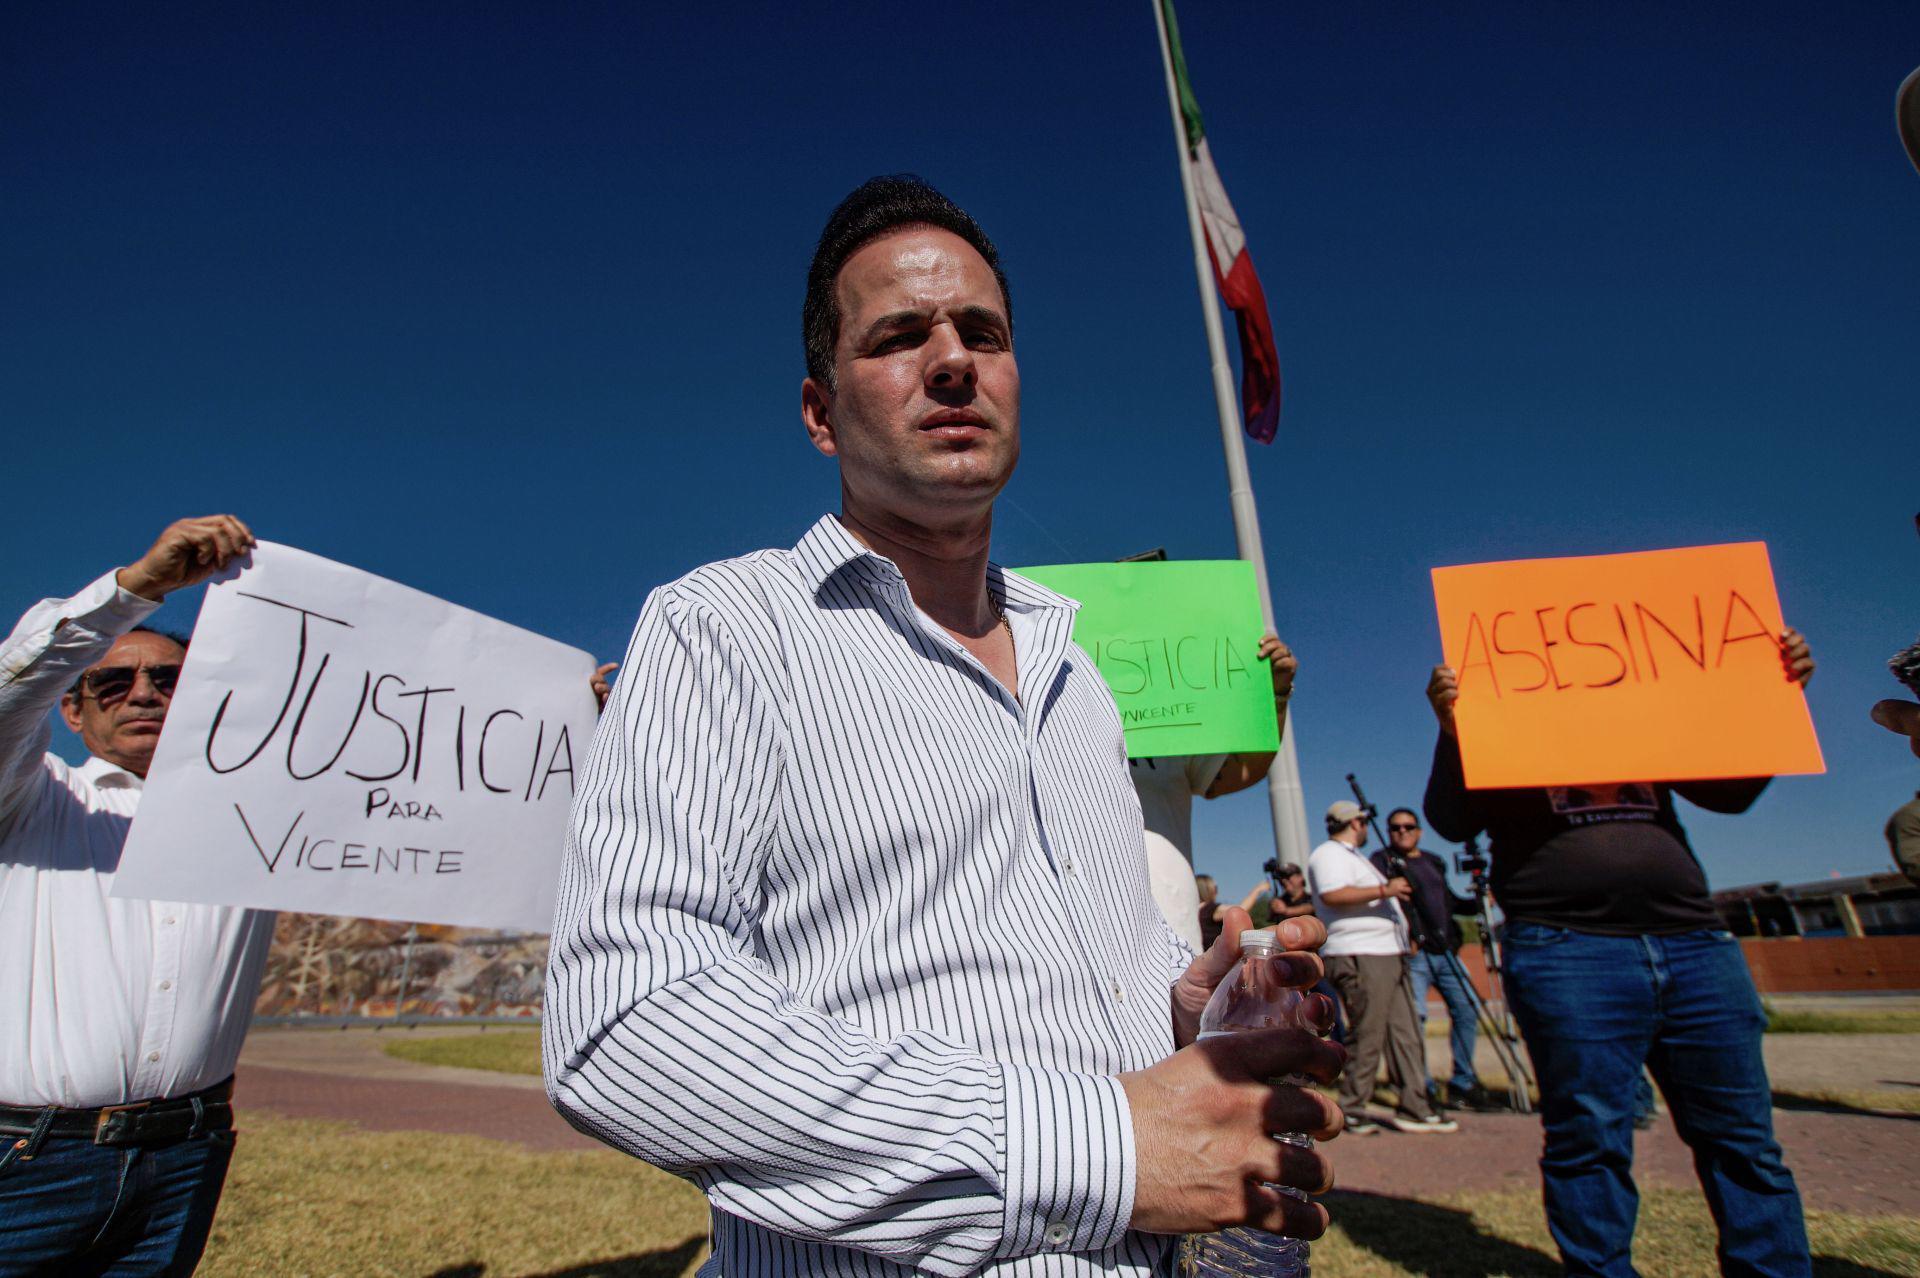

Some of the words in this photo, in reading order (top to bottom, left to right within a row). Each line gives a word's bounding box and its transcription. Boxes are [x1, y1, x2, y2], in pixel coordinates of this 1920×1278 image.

[1072, 635, 1251, 694] STICIA
[1456, 589, 1781, 699] ASESINA
[206, 591, 576, 802] JUSTICIA
[1128, 702, 1197, 722] VICENTE
[366, 787, 443, 821] PARA
[235, 802, 464, 873] VICENTE
